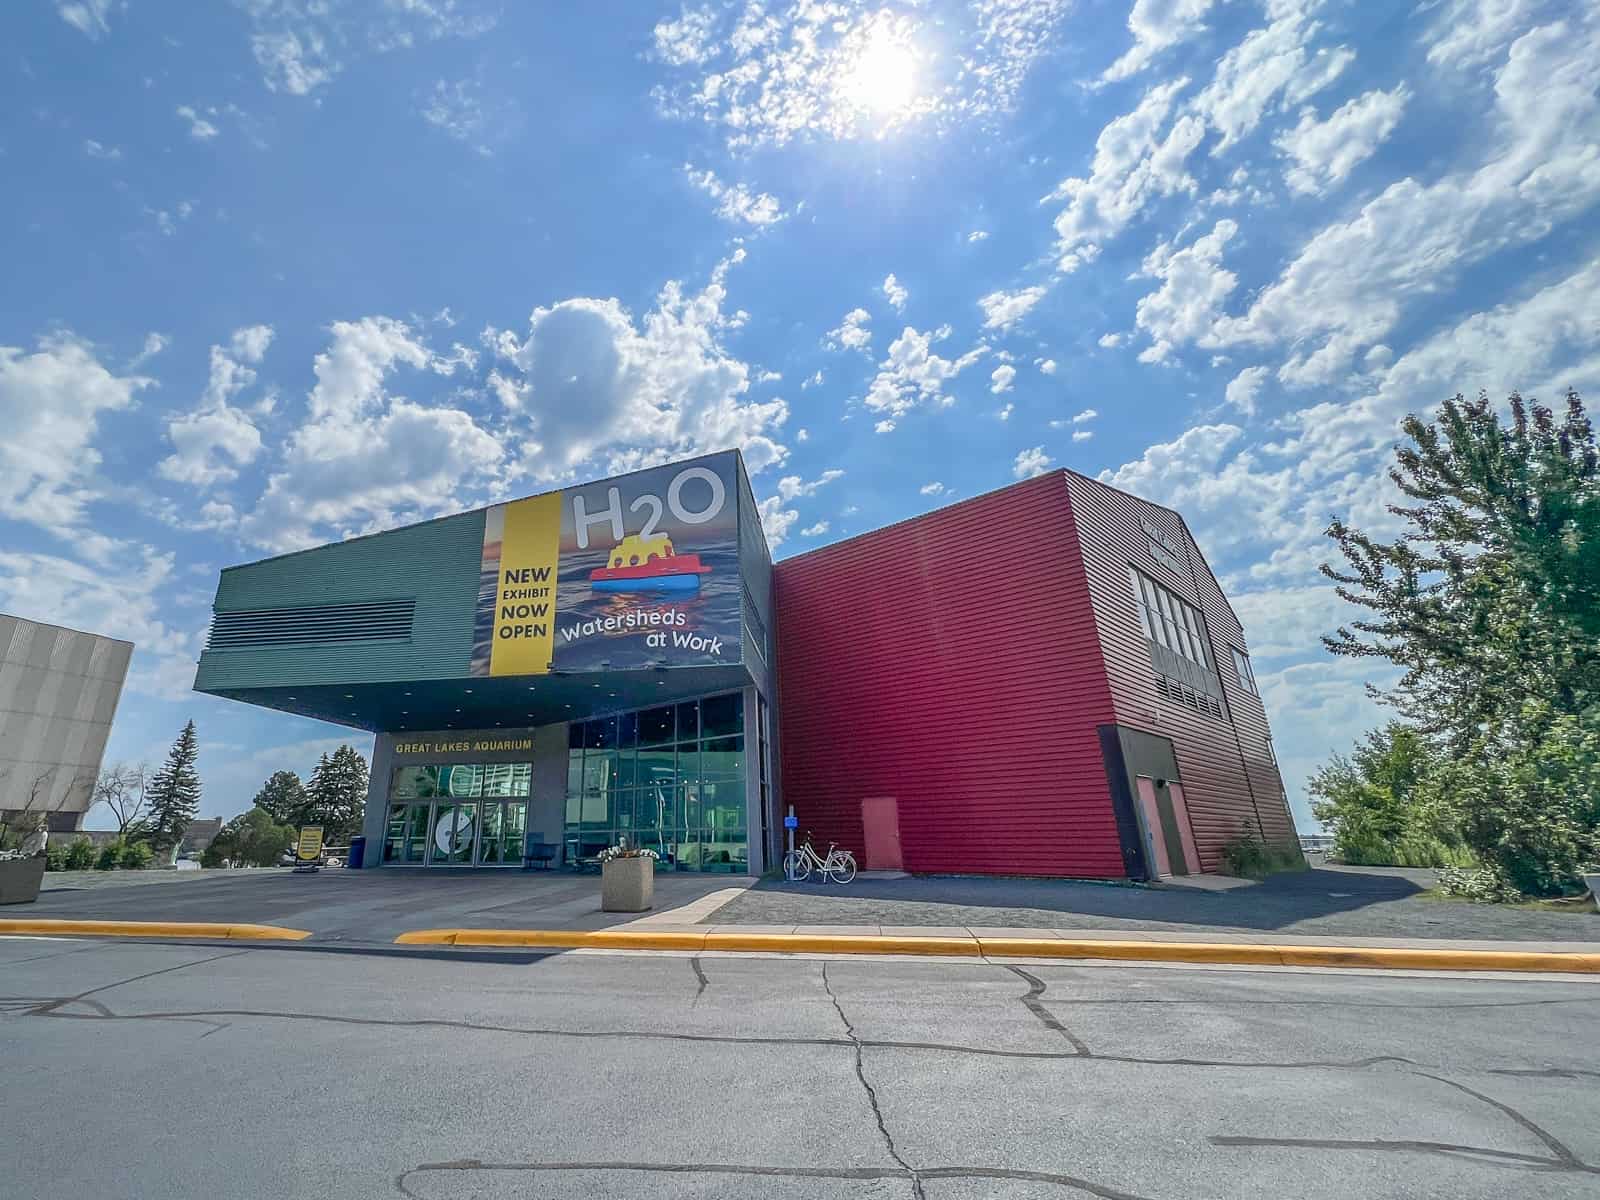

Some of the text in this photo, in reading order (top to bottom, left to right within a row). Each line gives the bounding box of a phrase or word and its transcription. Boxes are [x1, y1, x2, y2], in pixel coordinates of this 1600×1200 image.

[573, 466, 725, 549] H2O
[505, 567, 551, 584] NEW
[503, 588, 549, 600] EXHIBIT
[501, 604, 548, 620] NOW
[499, 624, 546, 639] OPEN
[561, 609, 686, 642] Watersheds
[646, 631, 723, 655] at Work
[396, 739, 532, 753] GREAT LAKES AQUARIUM
